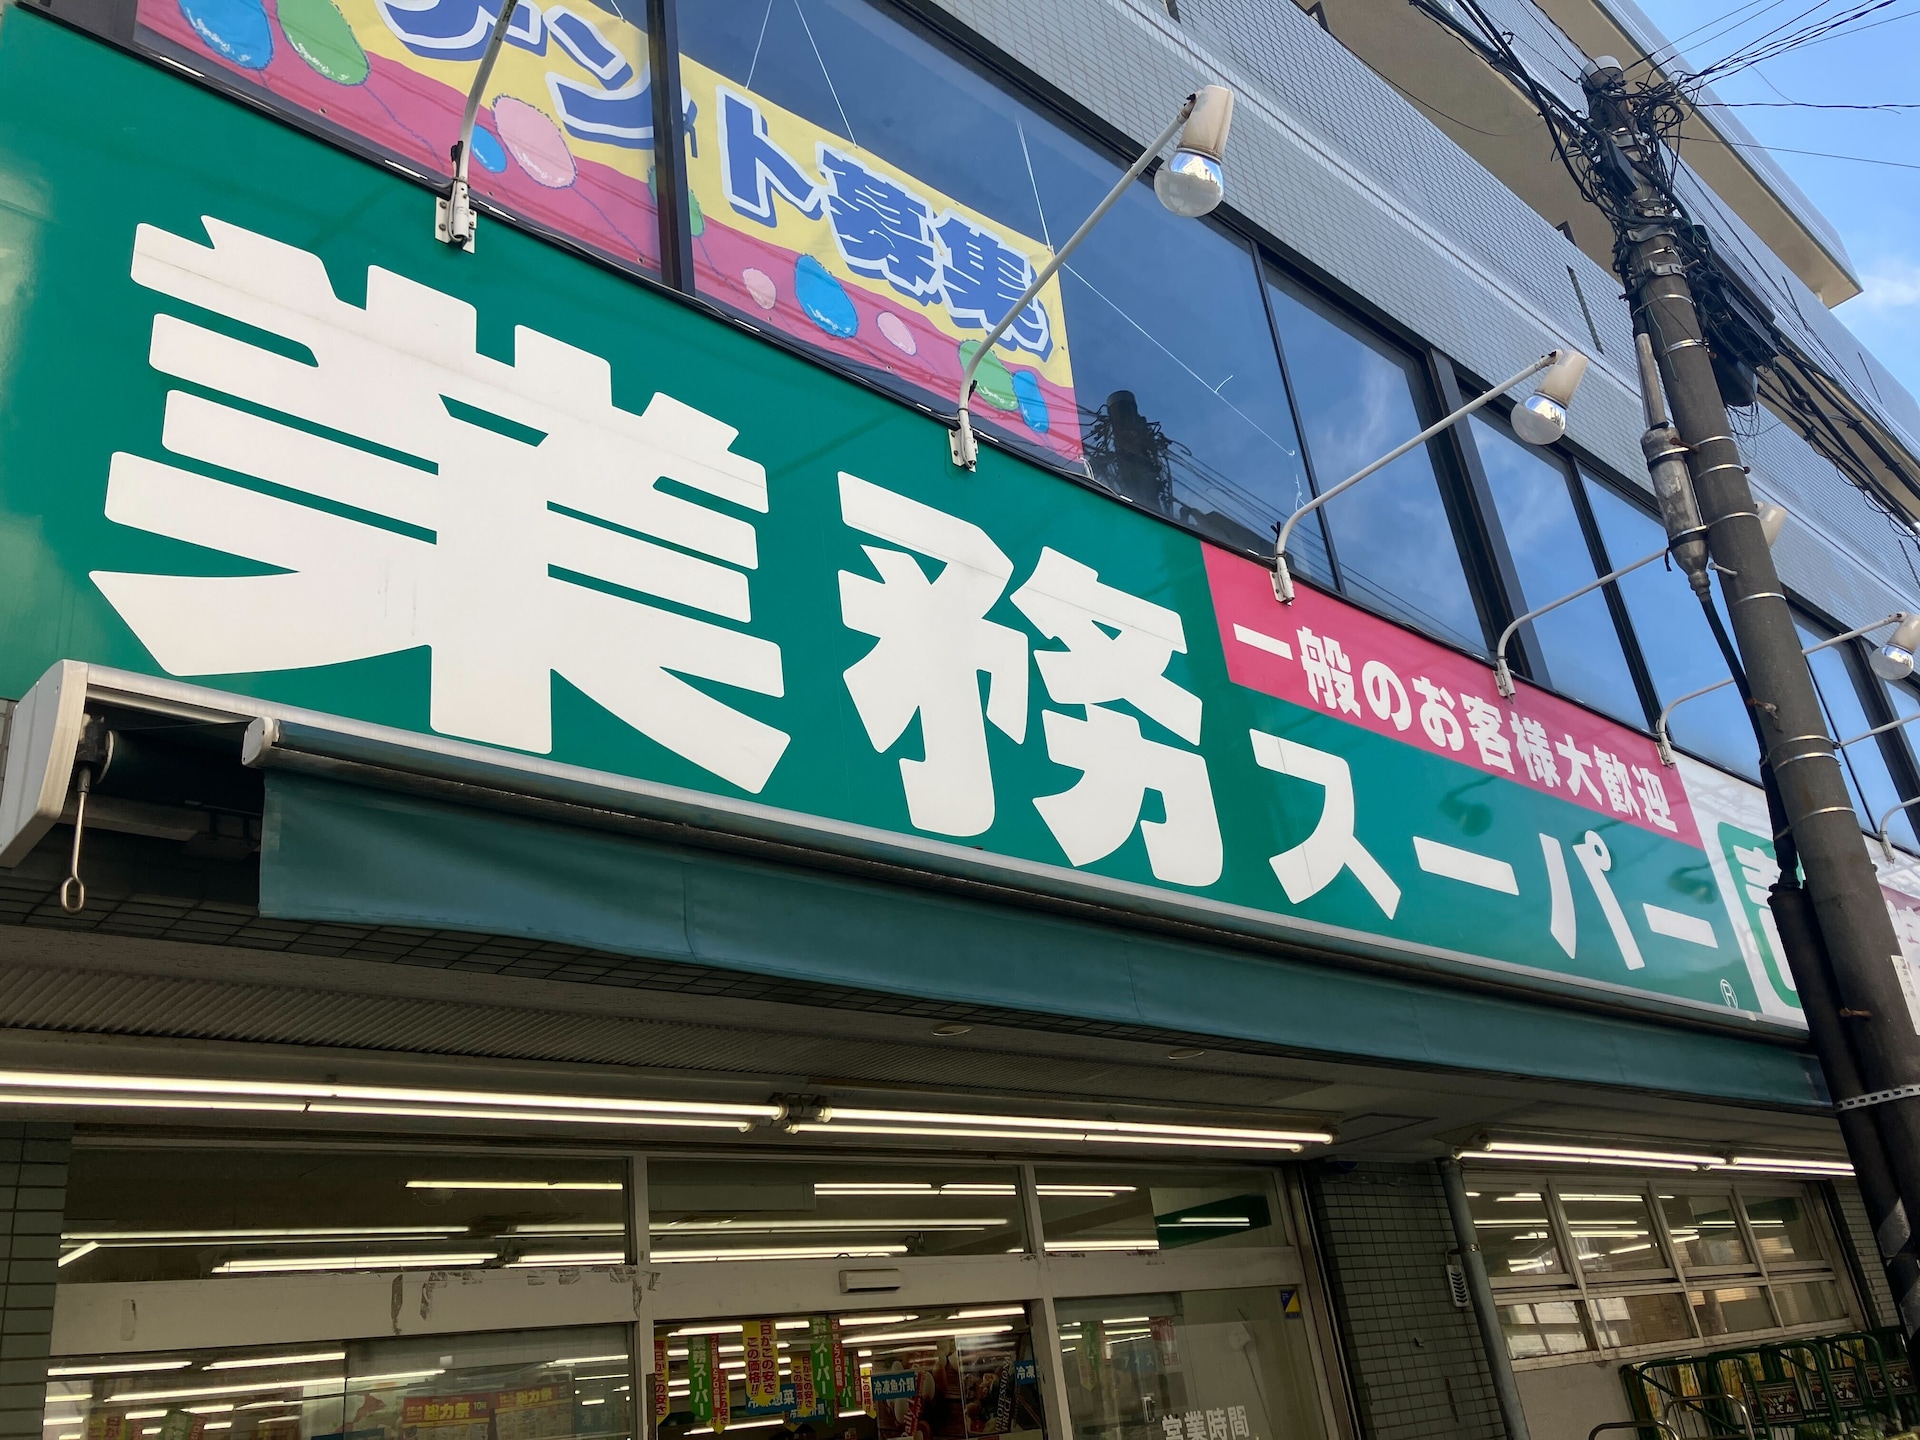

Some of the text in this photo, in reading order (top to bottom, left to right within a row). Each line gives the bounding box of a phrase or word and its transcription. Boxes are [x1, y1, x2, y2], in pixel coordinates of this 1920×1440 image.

[90, 216, 1718, 970] 業務スーパー
[1233, 622, 1678, 834] 一般のお客様大歓迎
[692, 1336, 708, 1416] 業務スーパー
[759, 1319, 775, 1394] 日がこの安さ
[874, 1377, 916, 1396] 冷凍魚介類
[1162, 1405, 1250, 1440] 営業時間
